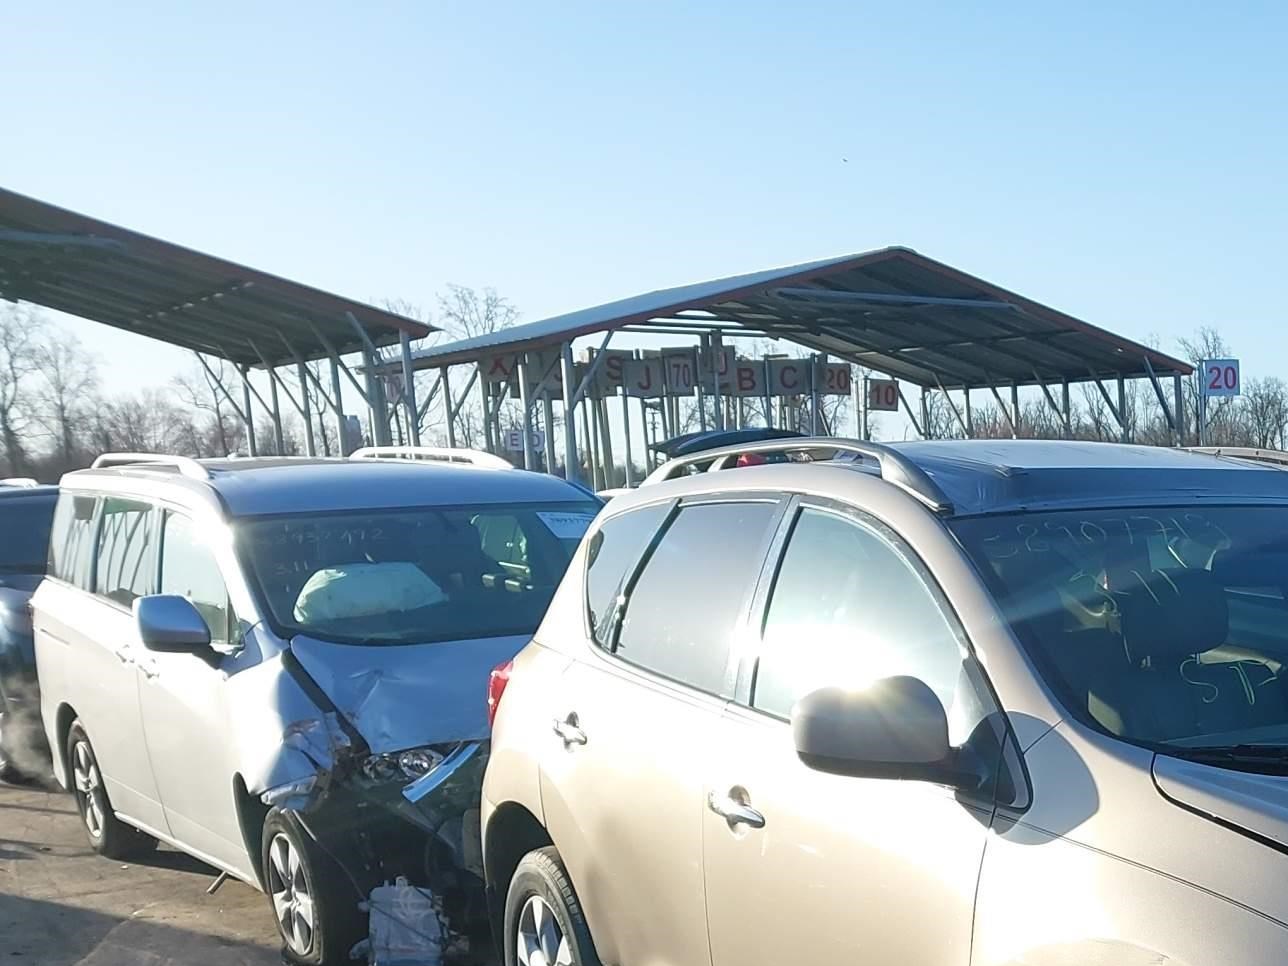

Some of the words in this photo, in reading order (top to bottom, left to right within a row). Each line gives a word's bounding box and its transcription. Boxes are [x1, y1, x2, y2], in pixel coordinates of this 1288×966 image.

[672, 363, 691, 388] 70
[736, 367, 757, 391] B
[780, 366, 798, 389] C
[826, 368, 849, 390] 20
[1208, 366, 1237, 390] 20
[872, 385, 896, 406] 10
